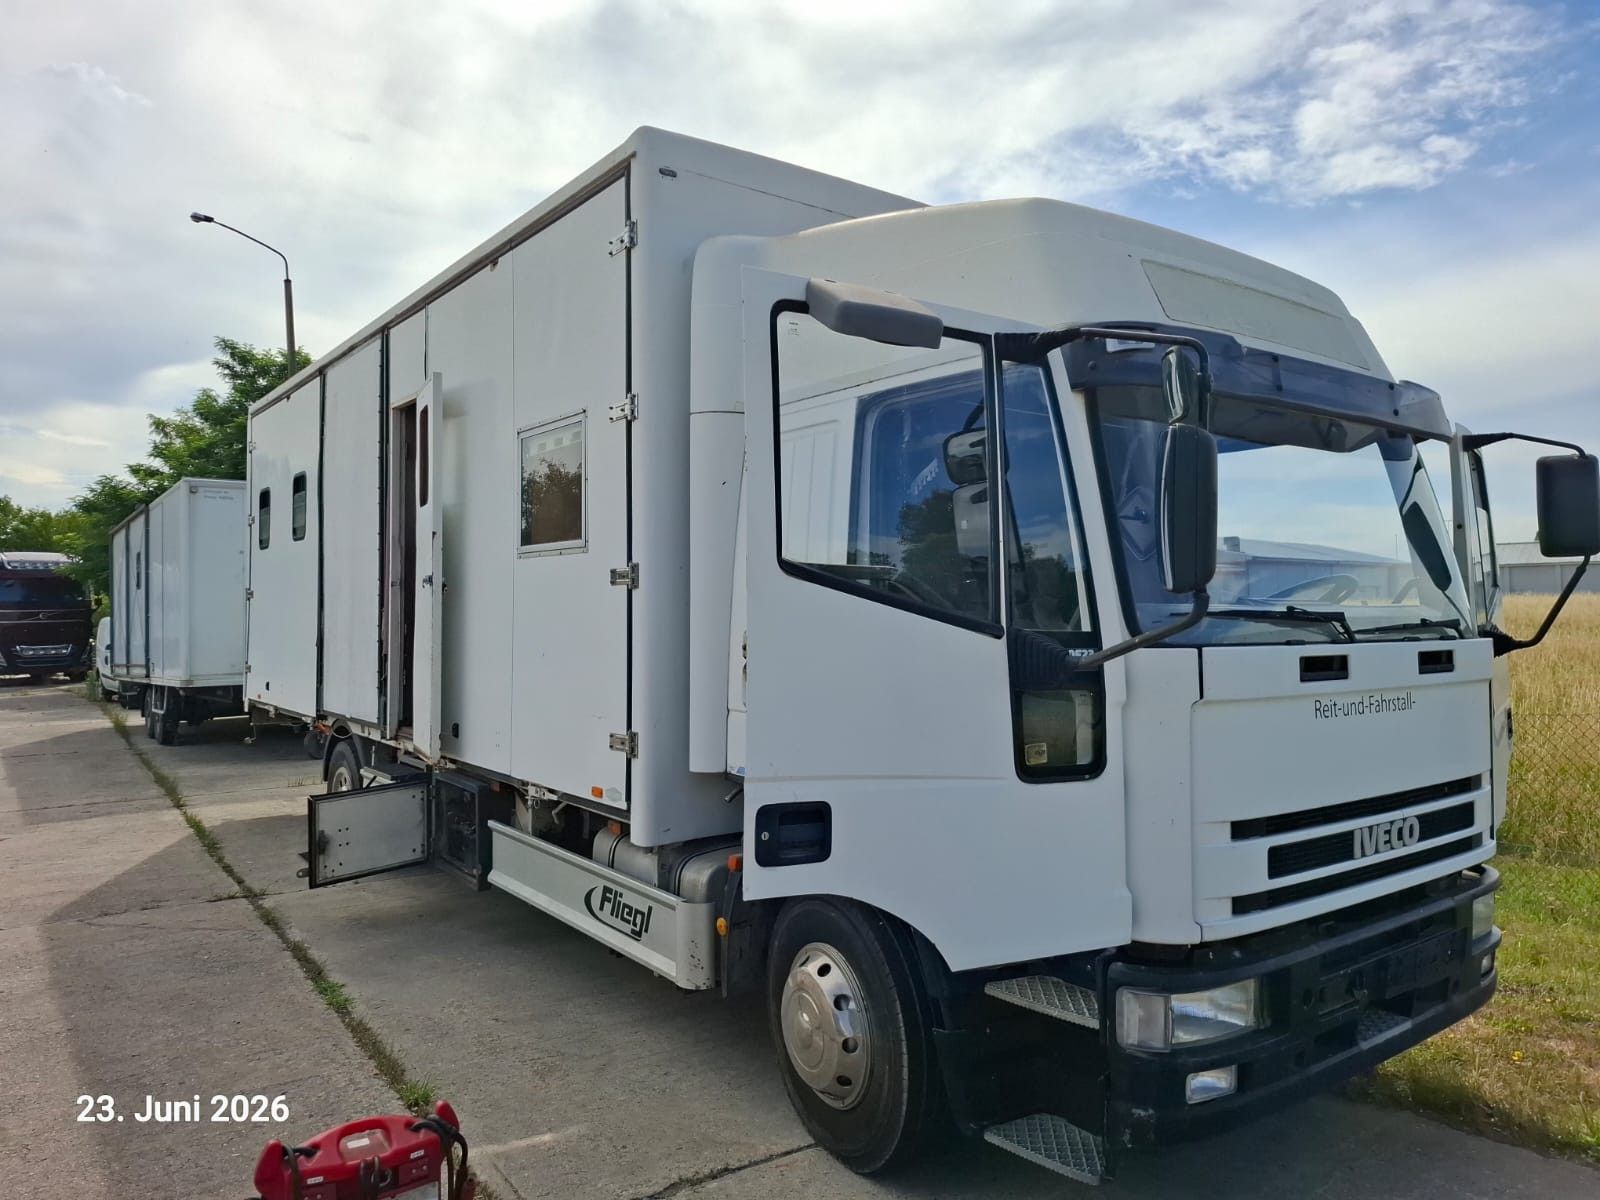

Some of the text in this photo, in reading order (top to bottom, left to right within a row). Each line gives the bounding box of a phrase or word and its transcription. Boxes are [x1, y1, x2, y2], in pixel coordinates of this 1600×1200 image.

[1314, 691, 1416, 720] Reit-und-Fahrstall-
[1353, 816, 1420, 859] IVECO
[599, 884, 653, 938] Fliegl
